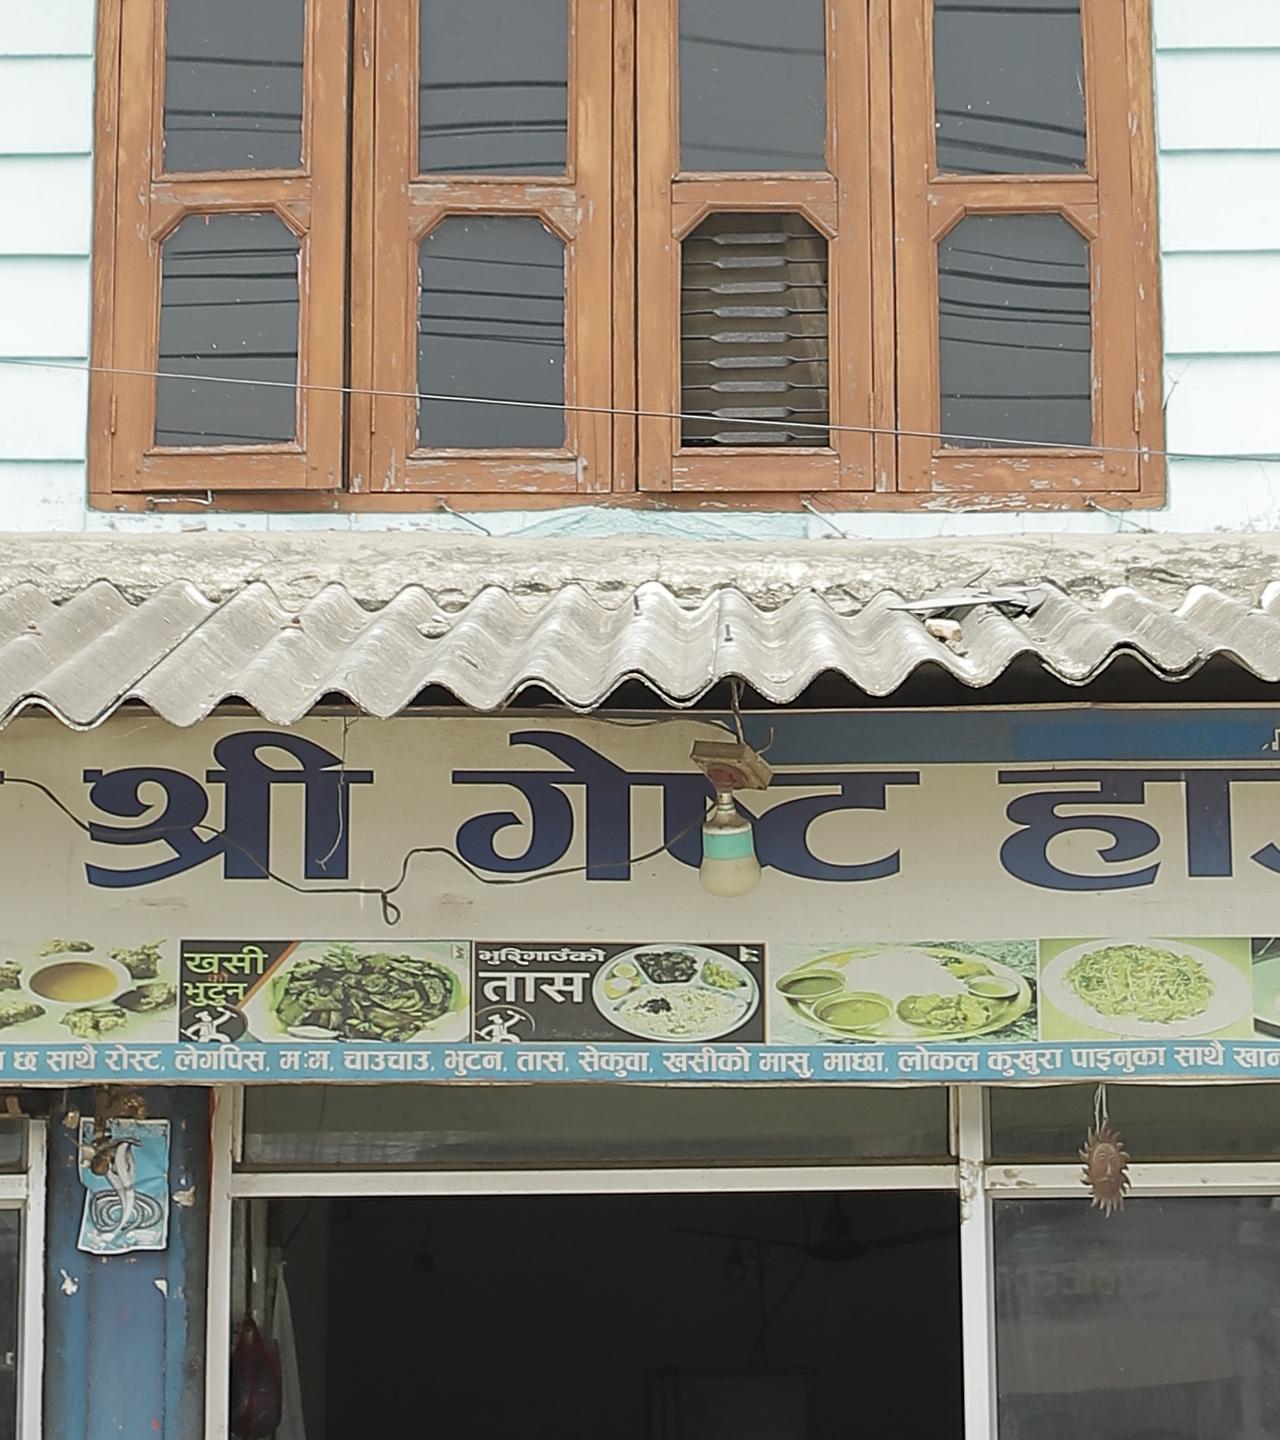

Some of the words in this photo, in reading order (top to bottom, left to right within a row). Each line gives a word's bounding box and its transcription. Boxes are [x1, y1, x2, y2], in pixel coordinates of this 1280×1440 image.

[80, 728, 375, 890] श्री
[183, 944, 269, 975] खसी
[478, 970, 591, 1003] तास
[13, 1051, 39, 1071] छ
[44, 1042, 99, 1072] साथै
[660, 1043, 754, 1073] खसीको
[897, 1043, 980, 1072] लोकल
[987, 1049, 1063, 1077] कुखुरा
[1070, 1047, 1167, 1073] पाइनुका
[1173, 1042, 1226, 1067] साथै
